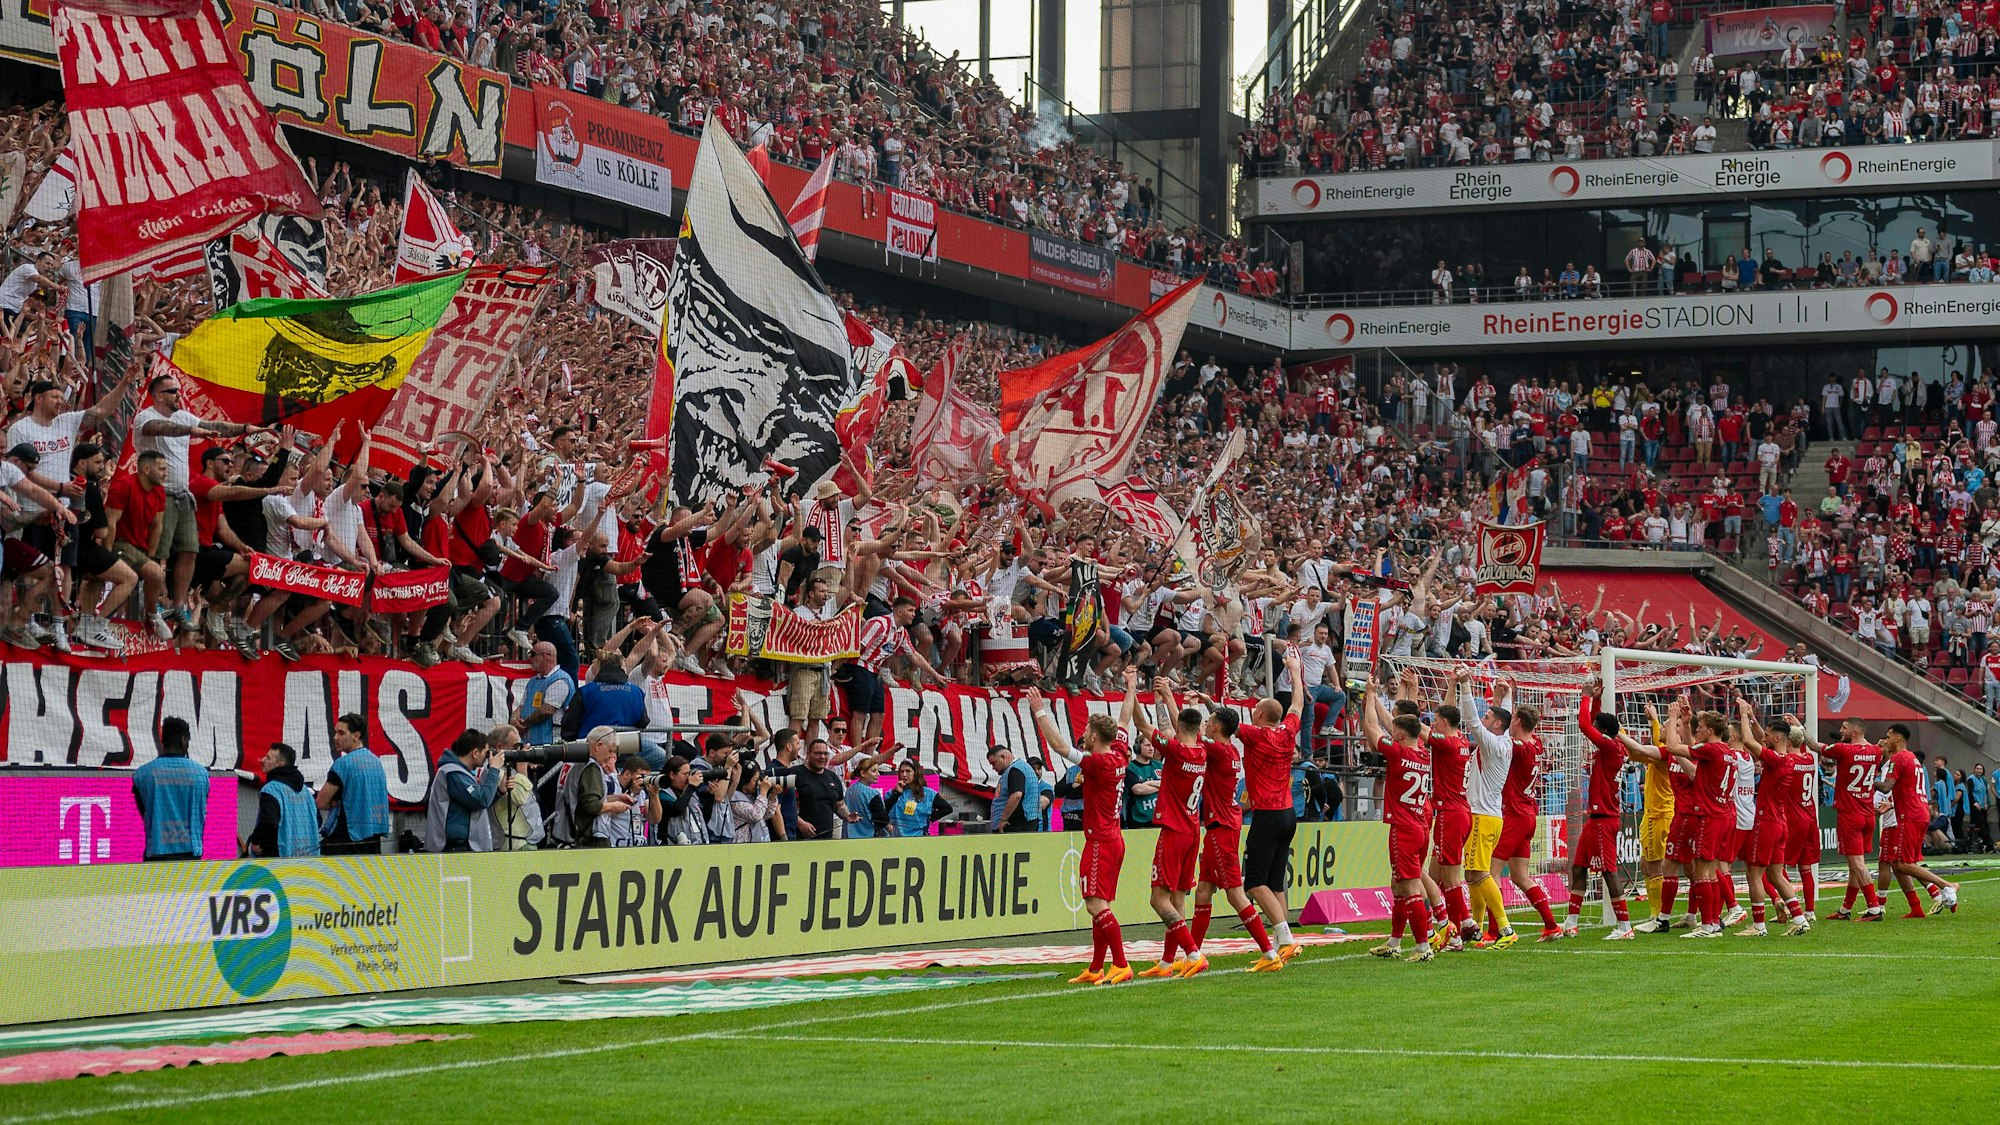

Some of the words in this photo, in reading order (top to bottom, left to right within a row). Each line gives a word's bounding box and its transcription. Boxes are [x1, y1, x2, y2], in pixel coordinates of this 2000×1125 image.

[213, 0, 501, 166] ÖLN
[587, 121, 665, 162] PROMINENZ
[596, 157, 611, 177] US
[617, 158, 660, 192] KÖLLE
[1720, 157, 1769, 172] Rhein
[1858, 157, 1956, 174] RheinEnergie
[1455, 172, 1501, 187] Rhein
[1585, 171, 1679, 188] RheinEnergie
[1715, 170, 1780, 188] Energie
[1325, 185, 1415, 201] RheinEnergie
[1450, 185, 1512, 202] Energie
[891, 191, 934, 225] COLONIA
[1032, 236, 1100, 271] WILDER-SÜDEN
[1228, 307, 1268, 331] RheinEnergie
[1904, 299, 2000, 316] RheinEnergie
[1360, 320, 1451, 336] RheinEnergie
[1478, 565, 1533, 583] COLONIACS
[729, 601, 748, 650] SEK
[7, 662, 242, 770] HEIM
[1400, 772, 1429, 805] 29
[1738, 786, 1755, 796] REWE
[1802, 772, 1813, 801] 9
[1847, 764, 1877, 792] 24
[1187, 775, 1204, 810] 8
[209, 893, 272, 936] VRS
[513, 868, 682, 955] STARK
[694, 862, 790, 941] AUF
[800, 856, 925, 933] JEDER
[938, 851, 1039, 921] LINIE.
[298, 901, 398, 932] ...verbindet!
[330, 941, 398, 956] Verkehrsverbund
[356, 957, 398, 974] Rhein-Sieg
